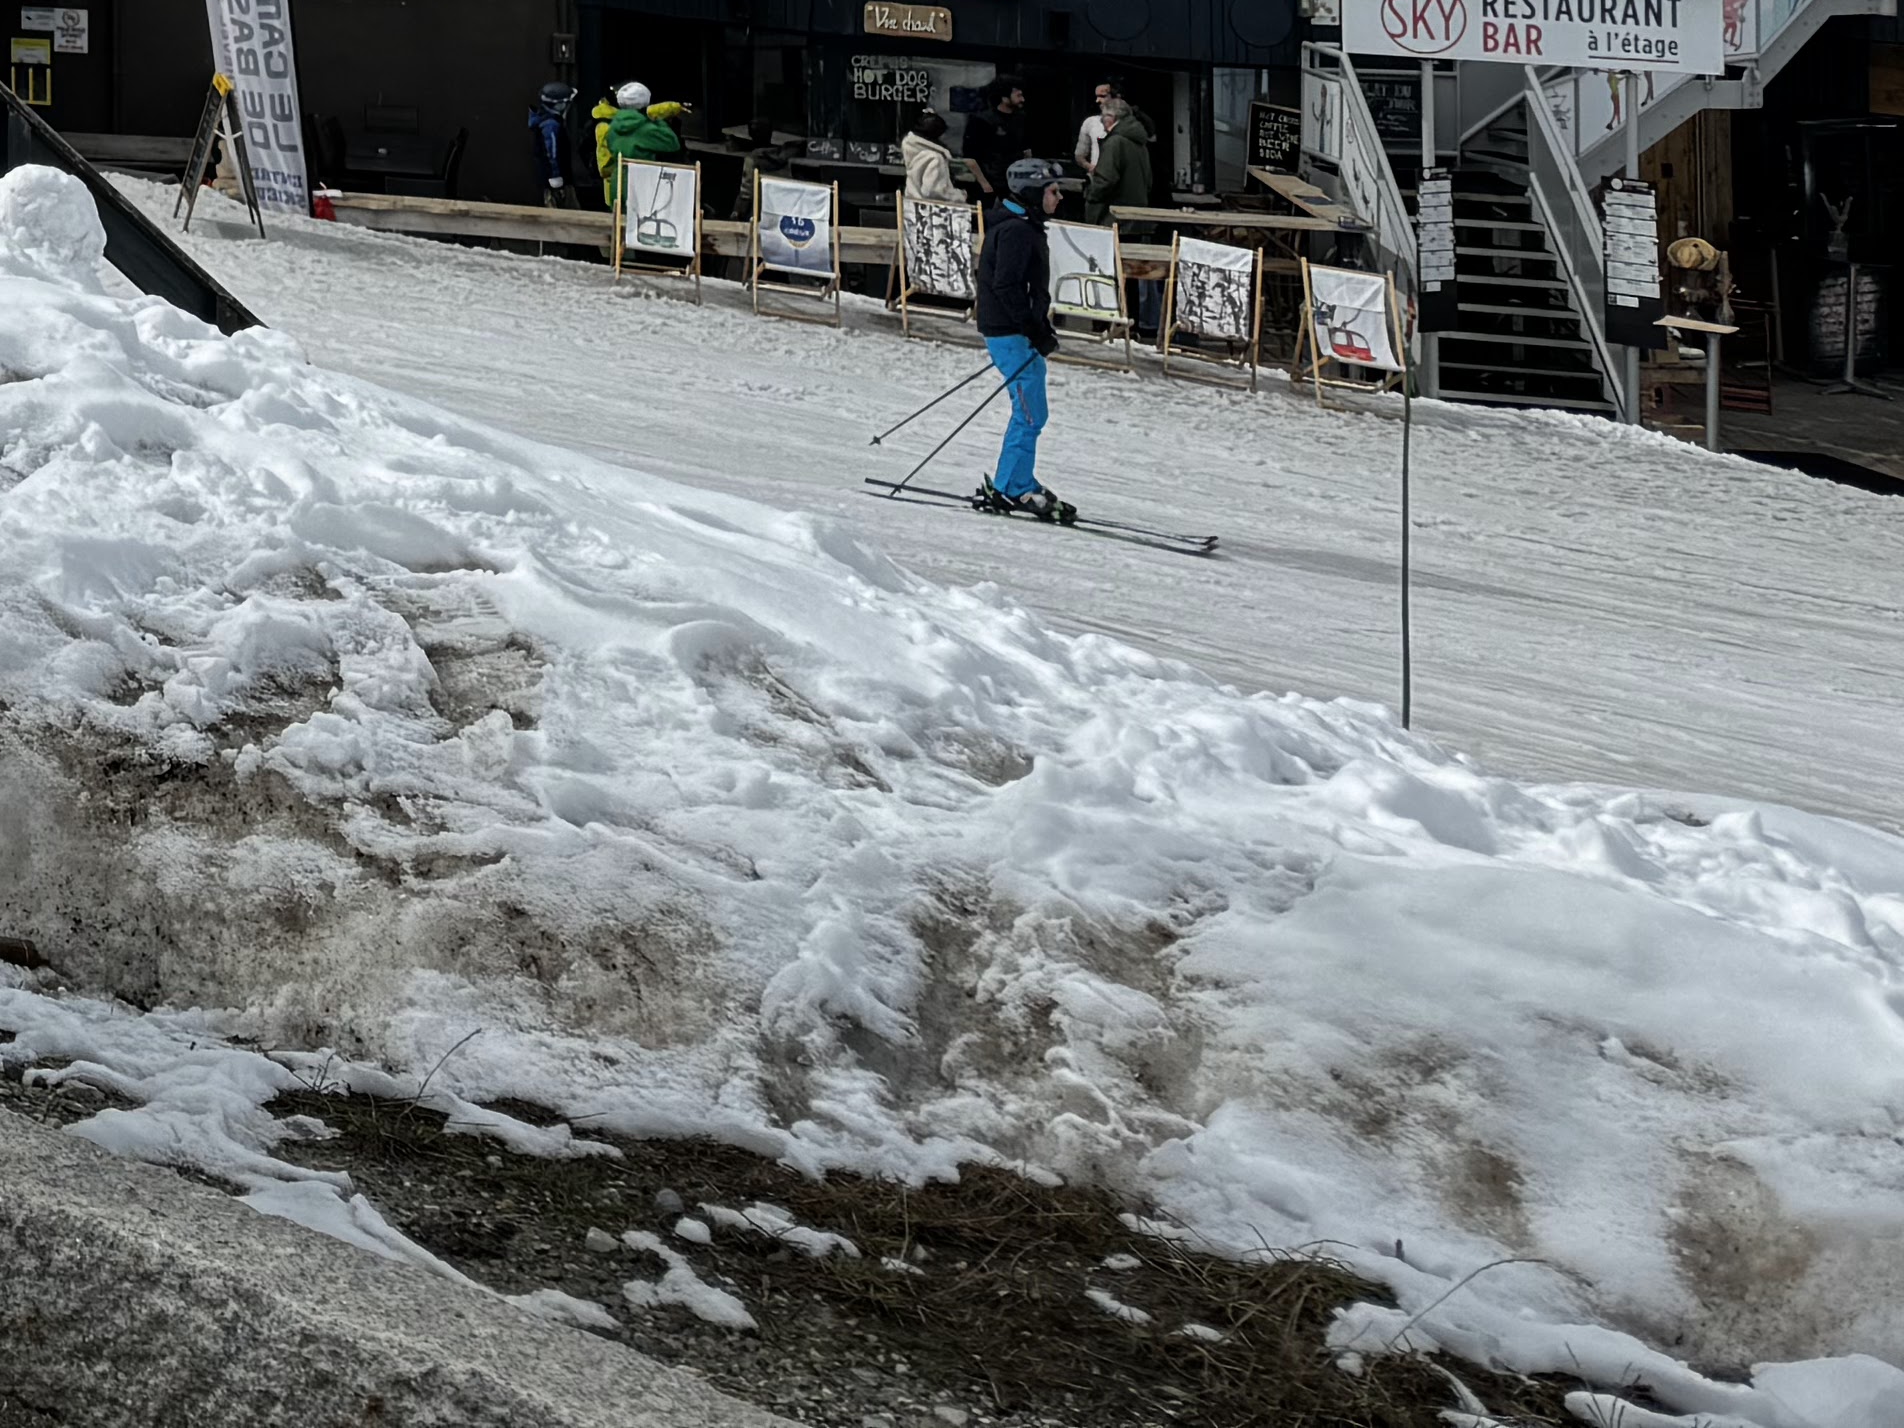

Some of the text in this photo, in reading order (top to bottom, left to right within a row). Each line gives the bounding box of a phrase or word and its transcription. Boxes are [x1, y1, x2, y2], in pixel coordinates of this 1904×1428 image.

[1482, 21, 1680, 58] BAR à l'étage
[853, 67, 928, 87] HOT DOG
